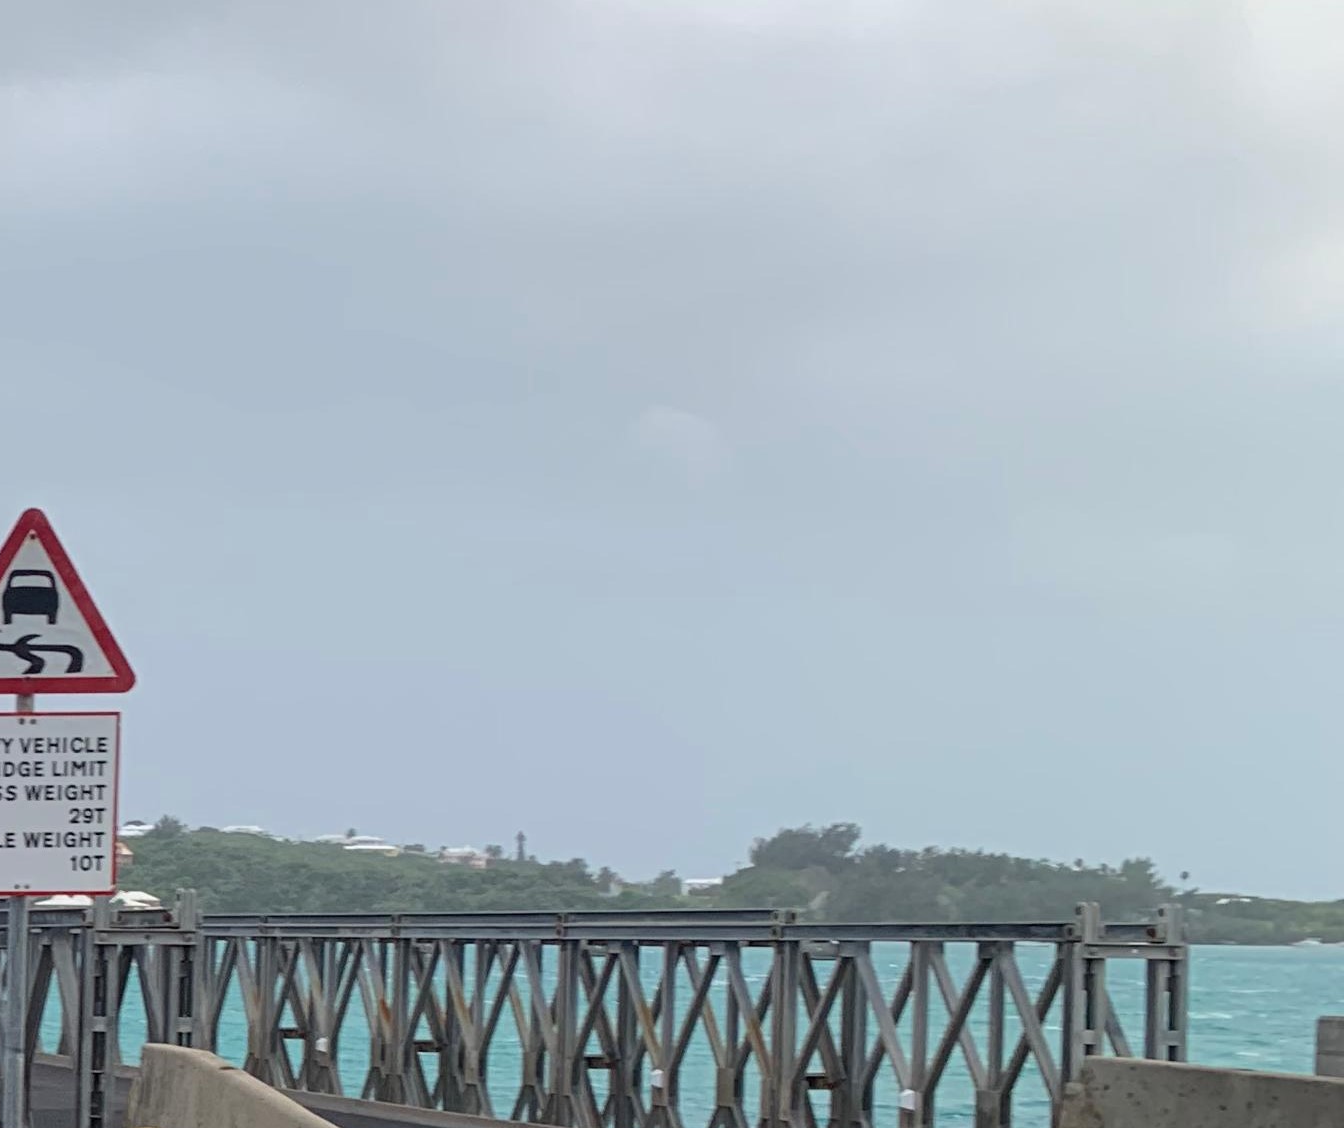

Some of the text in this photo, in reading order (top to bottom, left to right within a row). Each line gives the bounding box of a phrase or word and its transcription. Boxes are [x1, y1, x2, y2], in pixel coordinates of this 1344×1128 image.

[19, 737, 109, 754] VEHICLE
[51, 760, 108, 777] LIMIT
[24, 784, 107, 801] WEIGHT
[68, 808, 107, 825] 29T
[23, 831, 106, 848] WEIGHT
[69, 855, 105, 872] 10T
